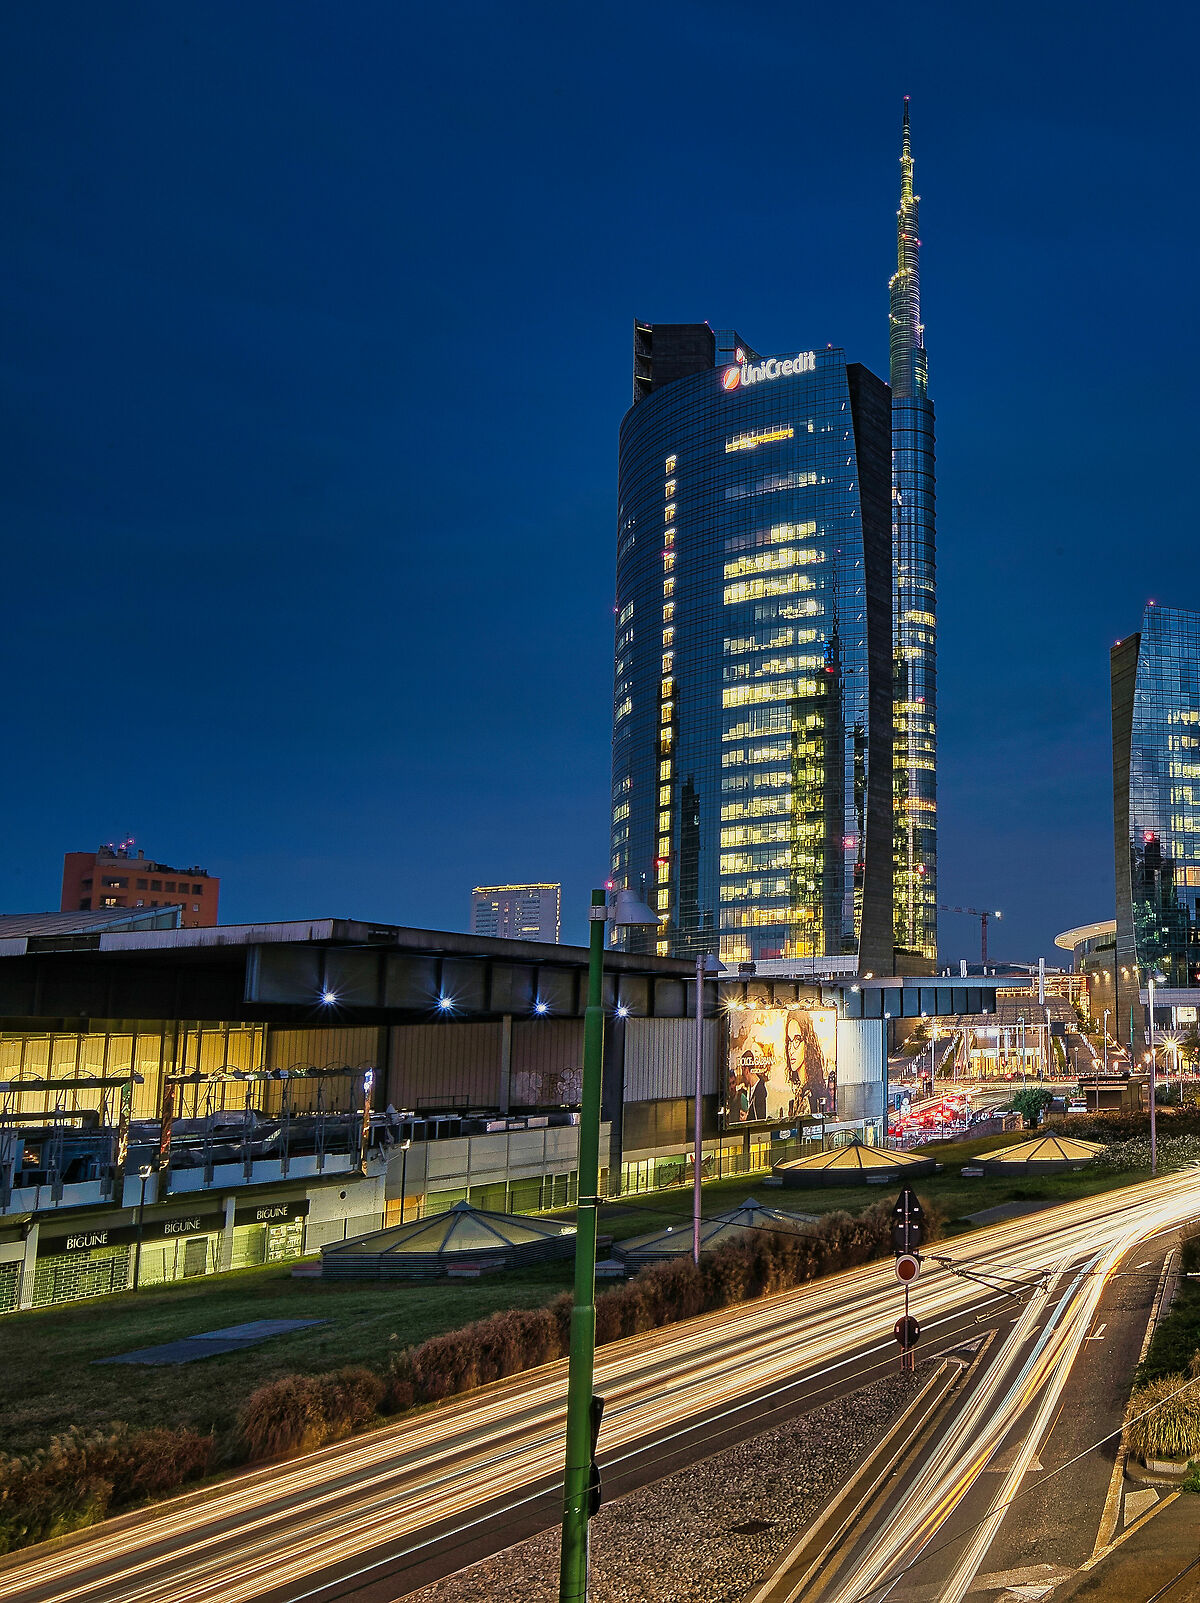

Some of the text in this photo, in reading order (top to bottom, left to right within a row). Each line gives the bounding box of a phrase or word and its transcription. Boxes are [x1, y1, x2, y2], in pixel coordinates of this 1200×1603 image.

[741, 351, 816, 386] UniCredit
[256, 1206, 289, 1220] BIGUINE
[164, 1219, 201, 1234] BIGUINE
[66, 1233, 108, 1250] BIGUINE
